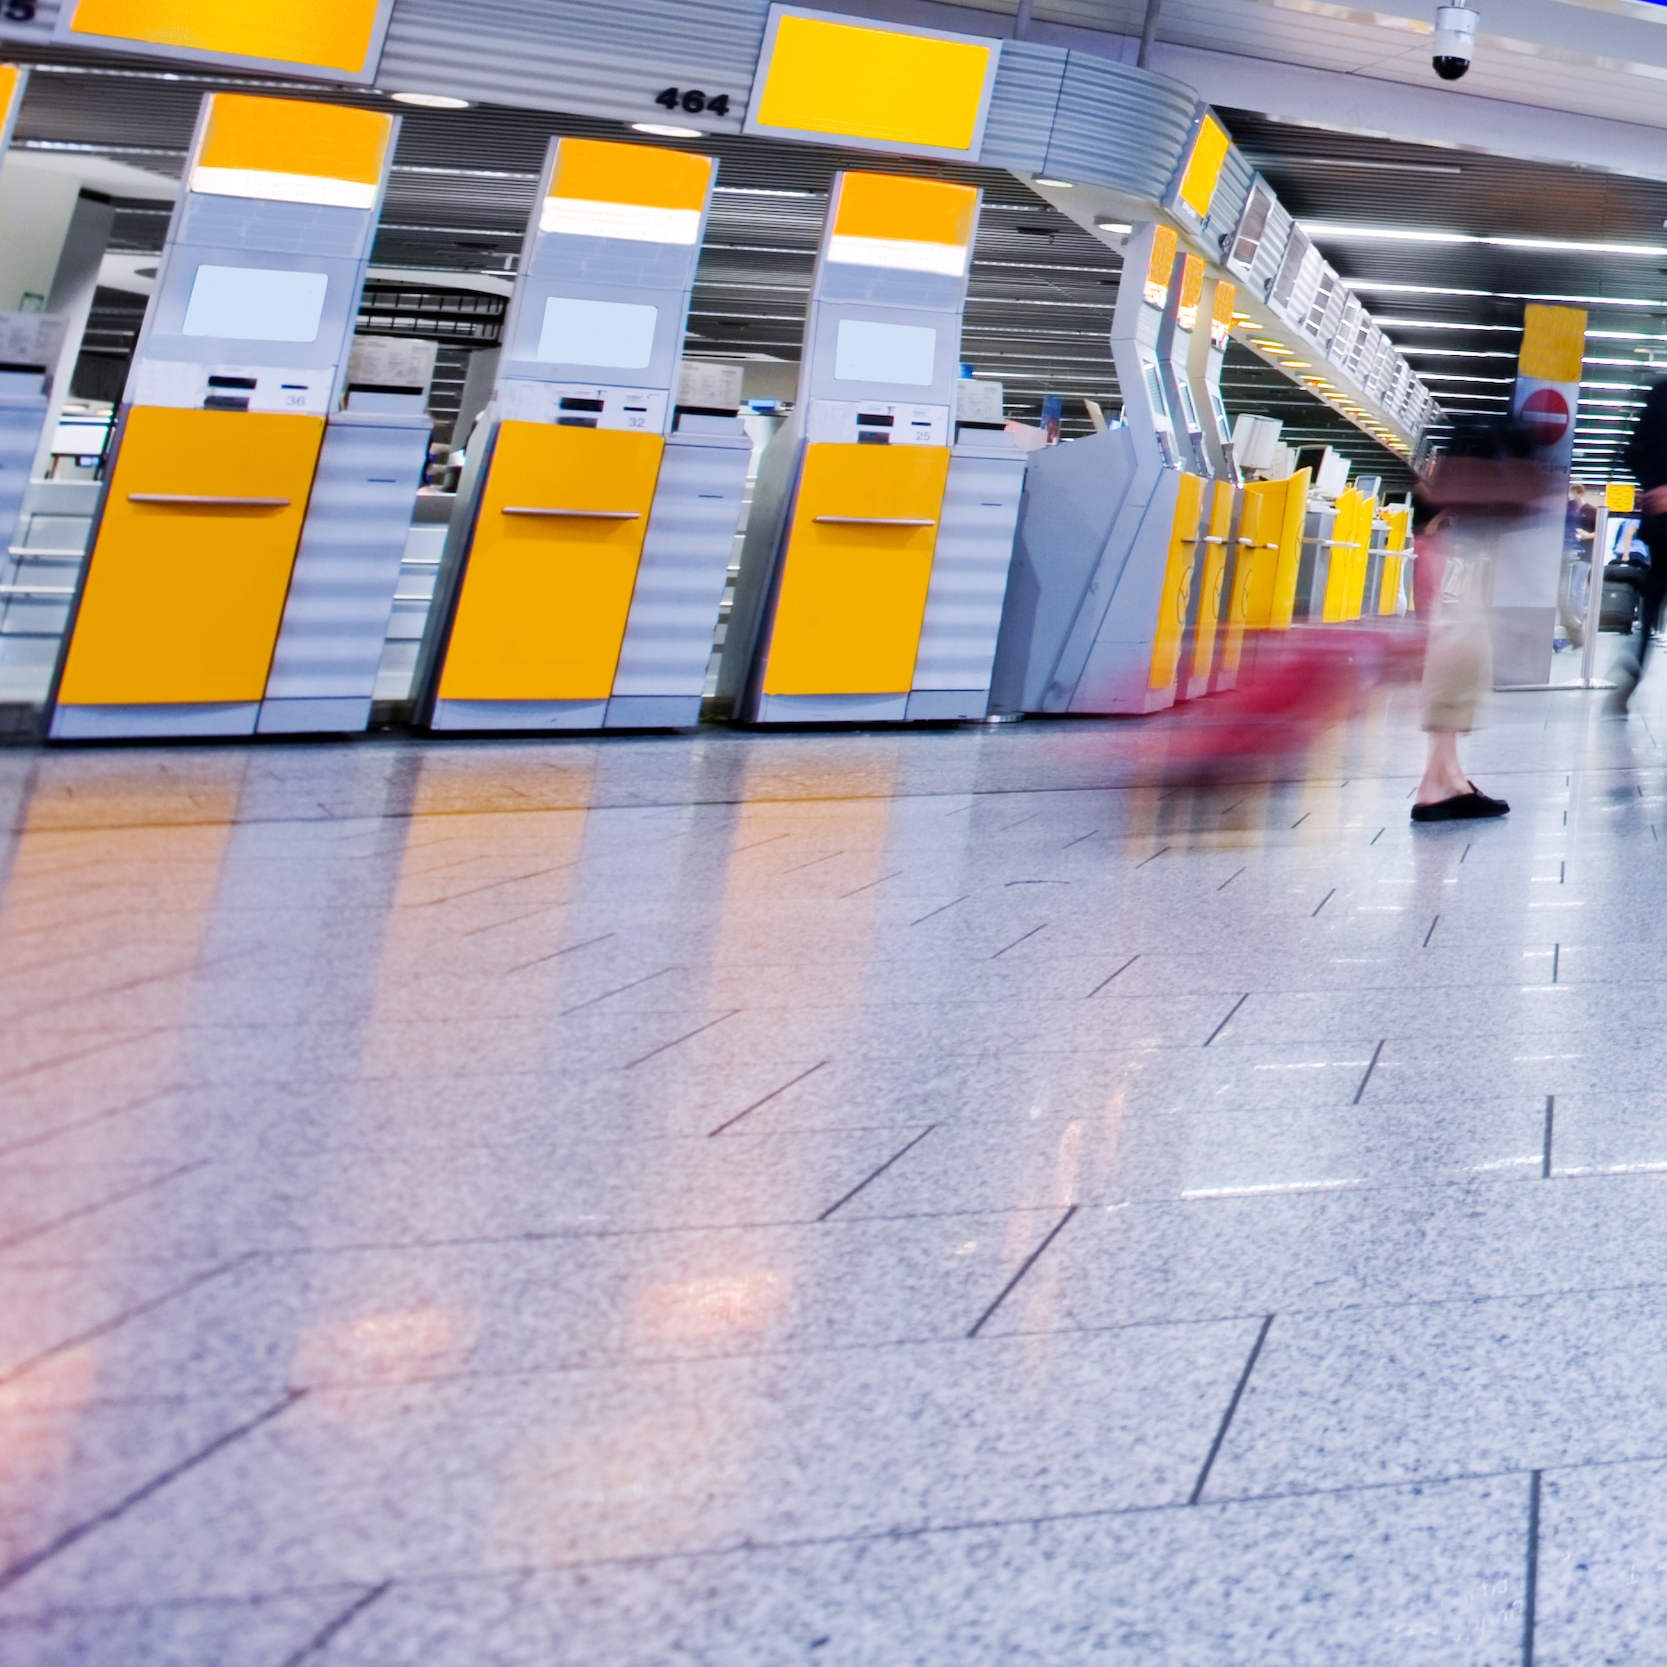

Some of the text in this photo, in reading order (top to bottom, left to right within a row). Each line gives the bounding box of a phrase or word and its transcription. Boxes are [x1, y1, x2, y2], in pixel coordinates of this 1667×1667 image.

[656, 88, 730, 116] 464
[628, 418, 645, 428] 32
[916, 432, 930, 440] 25
